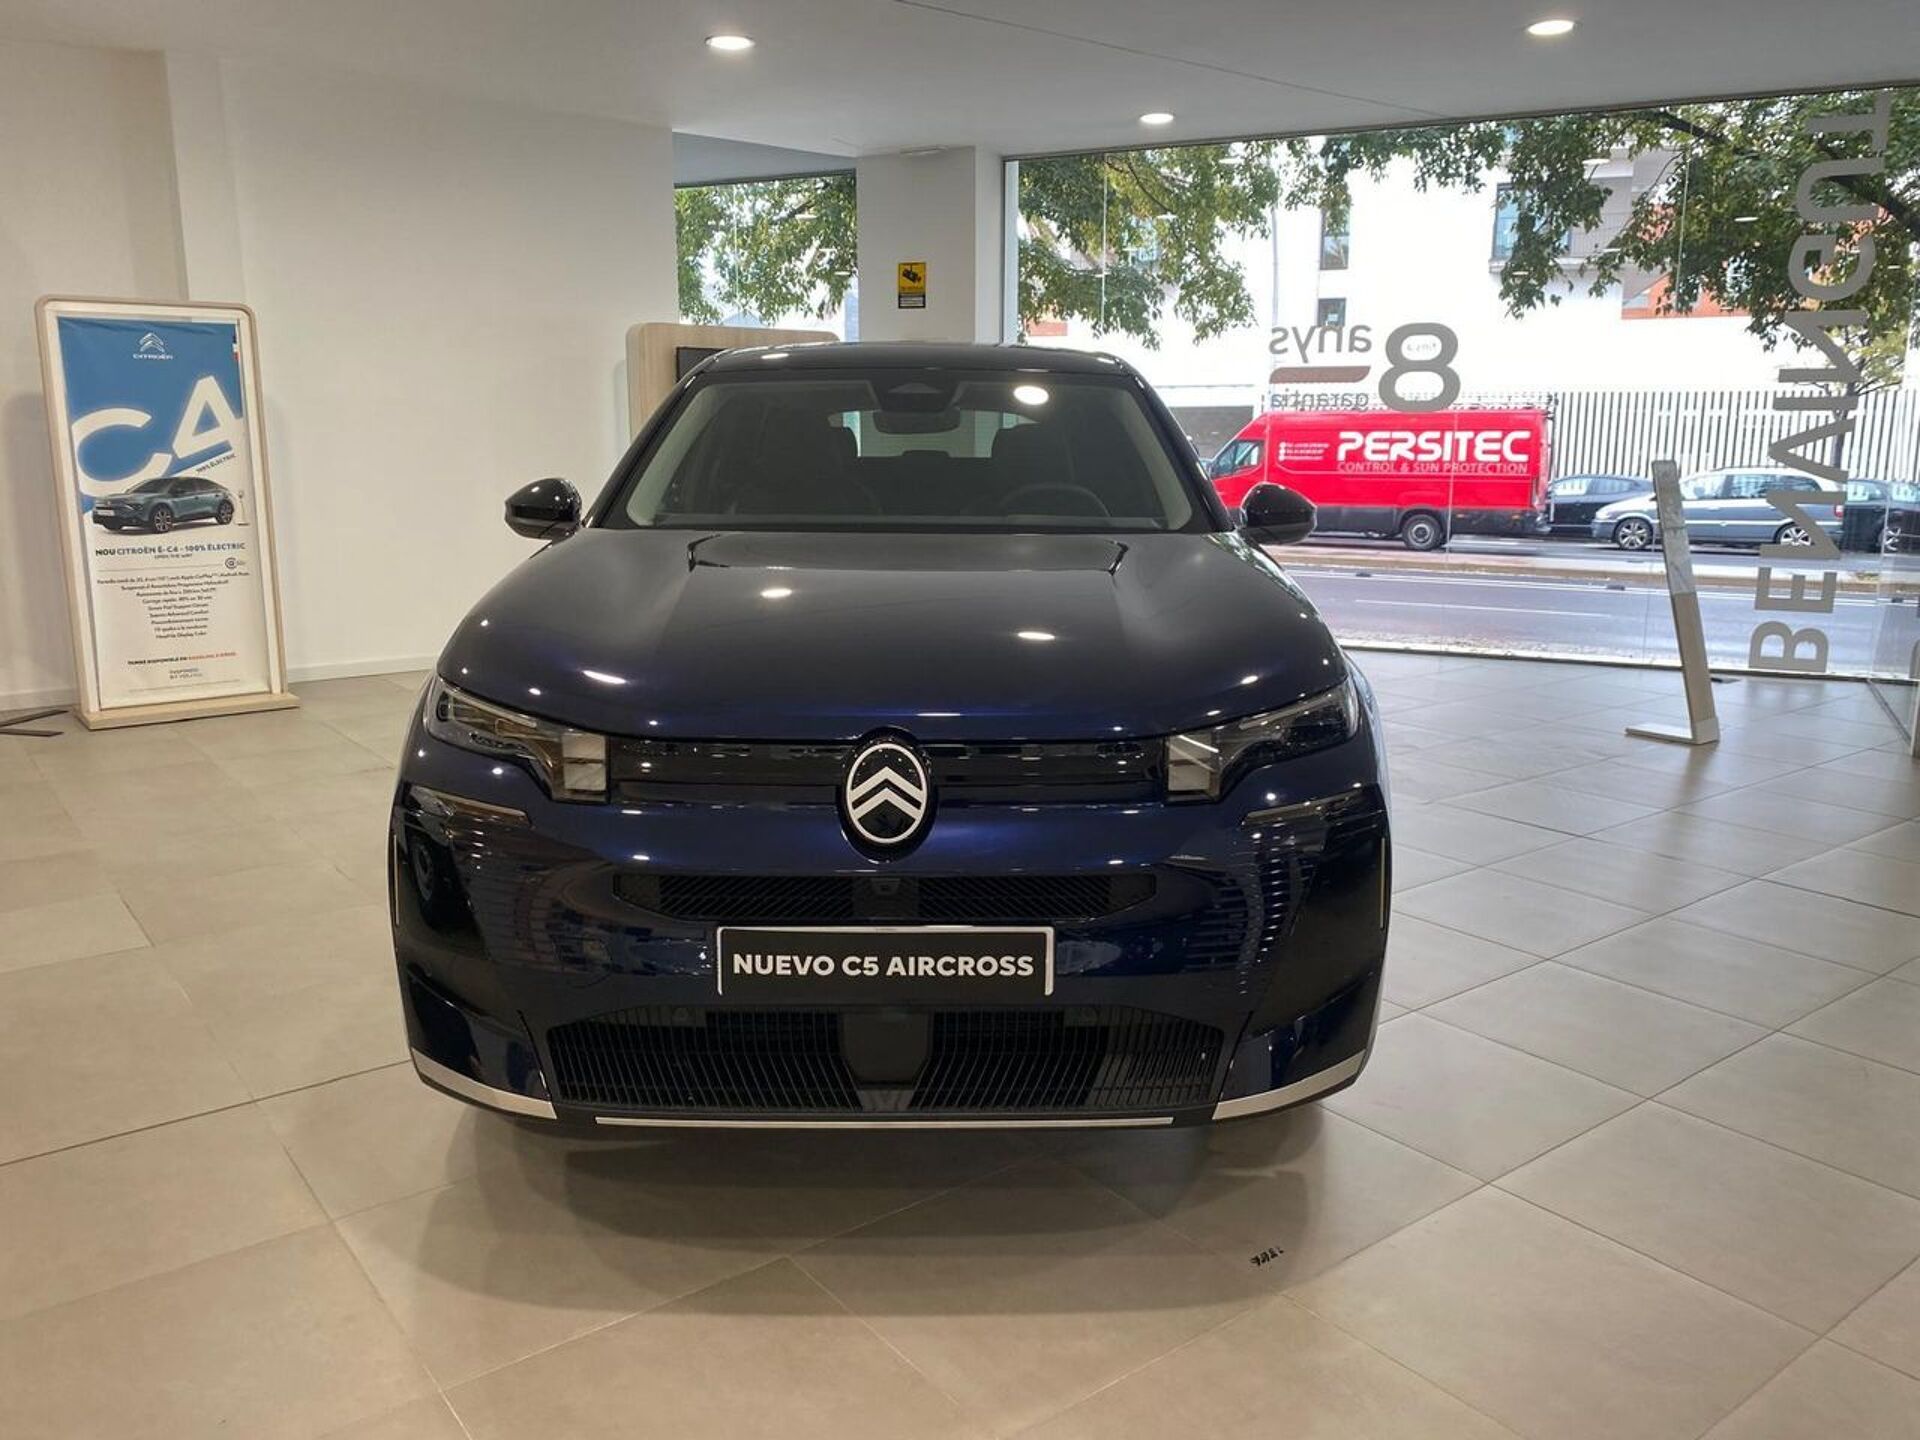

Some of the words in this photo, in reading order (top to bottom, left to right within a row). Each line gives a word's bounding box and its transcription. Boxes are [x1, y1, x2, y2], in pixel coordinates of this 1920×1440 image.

[72, 375, 243, 498] C4
[1336, 430, 1532, 462] PERSITEC
[1337, 461, 1396, 474] CONTROL
[1401, 461, 1409, 474] &
[1412, 461, 1439, 474] SUN
[1442, 461, 1529, 474] PROTECTION
[95, 548, 116, 556] NOU
[185, 544, 206, 552] 100%
[732, 953, 835, 976] NUEVO
[841, 955, 879, 977] C5
[886, 955, 1035, 977] AIRCROSS
